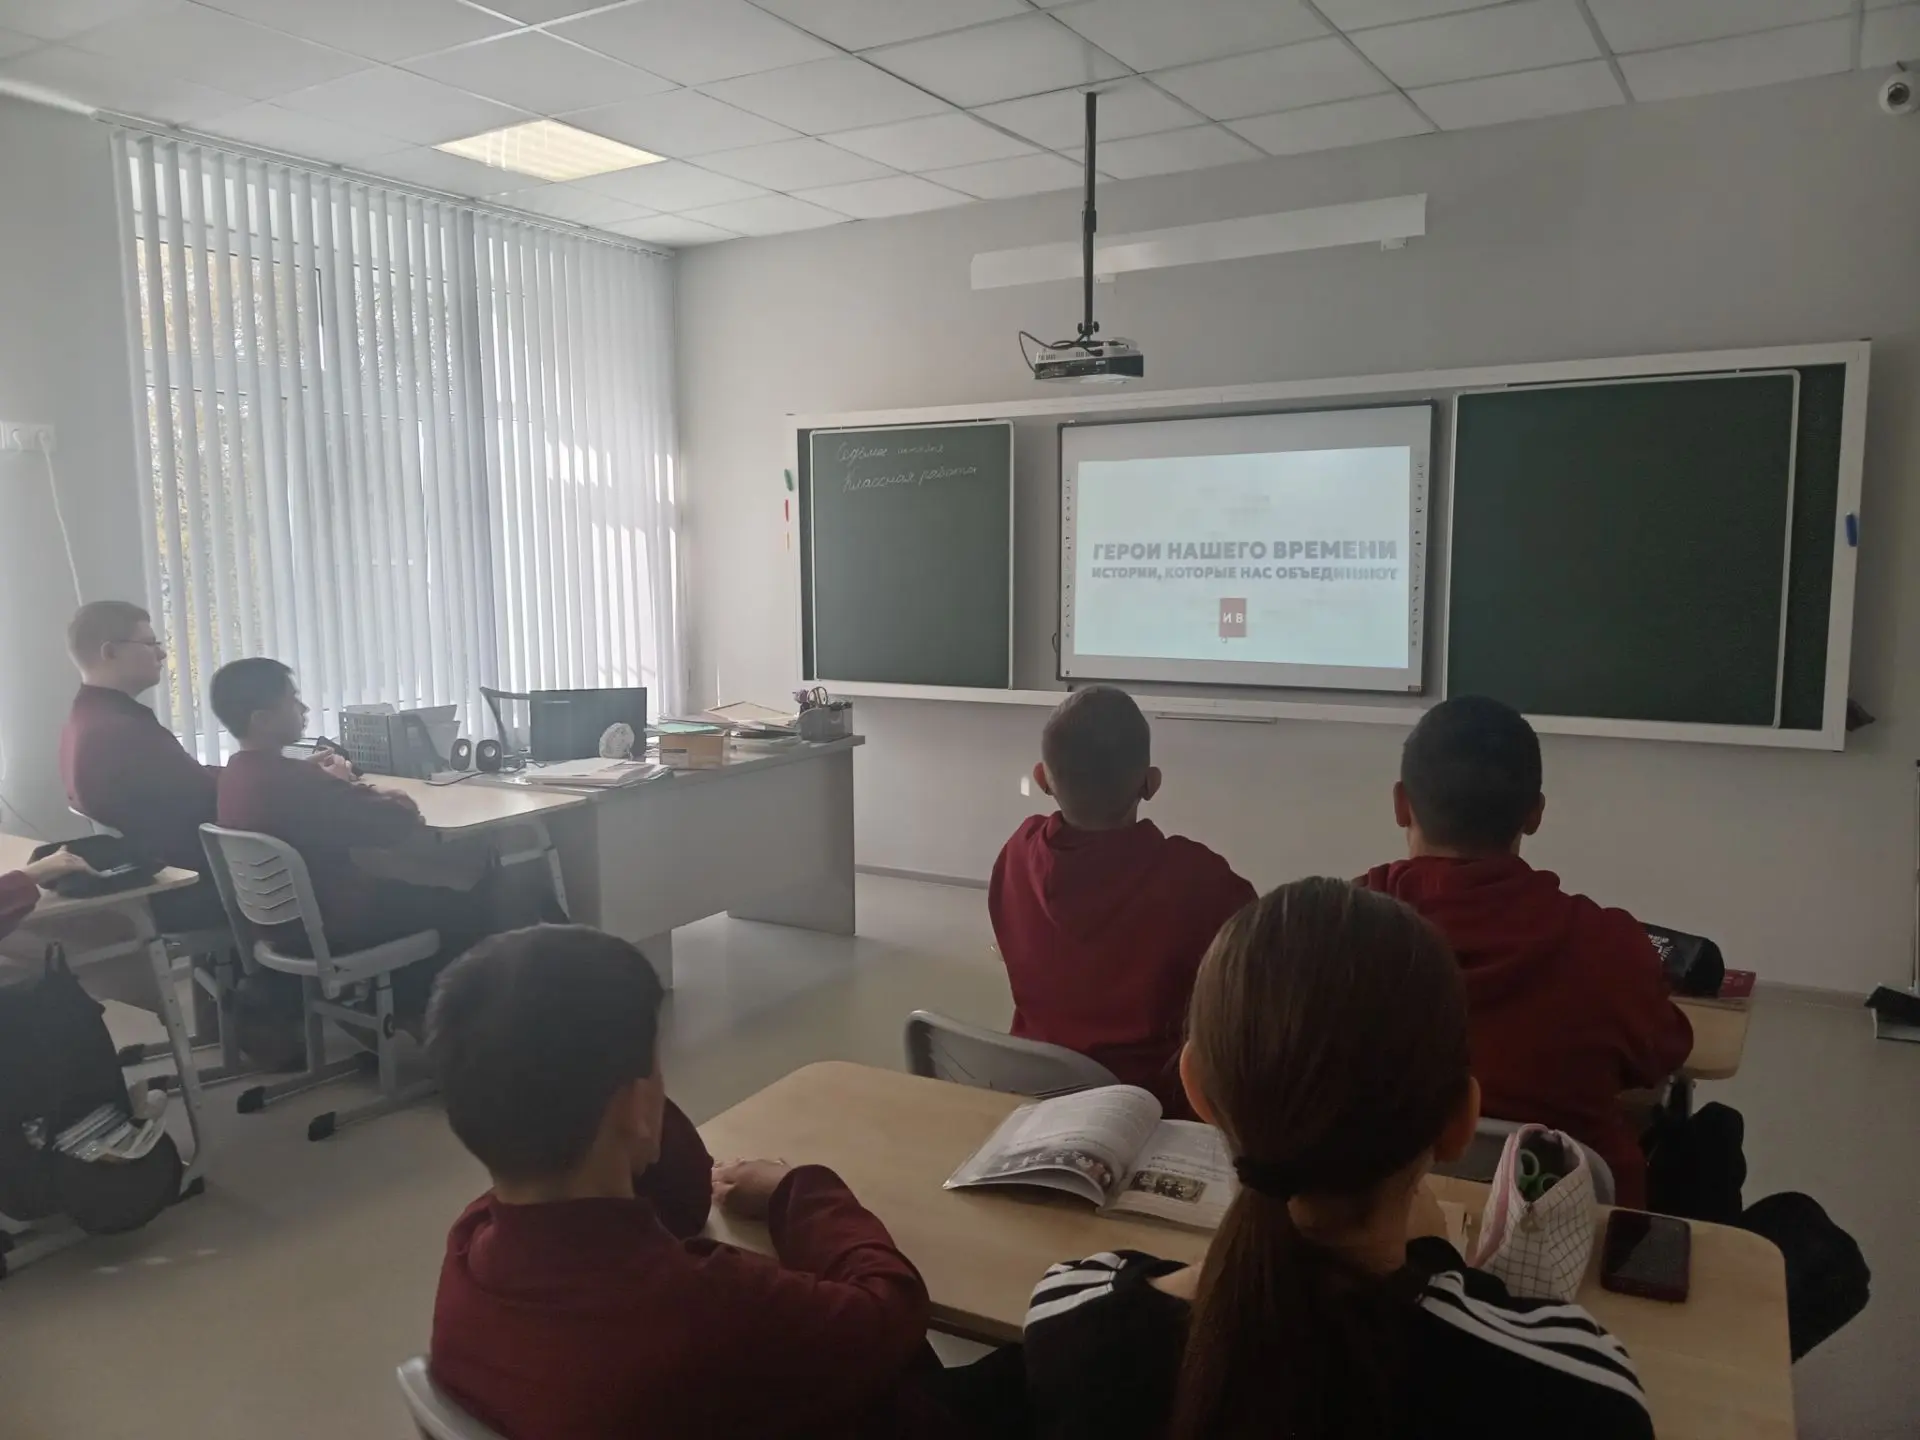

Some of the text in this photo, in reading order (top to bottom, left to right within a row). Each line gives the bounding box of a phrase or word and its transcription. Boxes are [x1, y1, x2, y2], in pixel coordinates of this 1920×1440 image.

[1093, 541, 1397, 560] ГЕРОИ НАШЕГО ВРЕМЕНИ
[1092, 567, 1161, 580] ИСТОРИИ,
[1165, 567, 1237, 579] КОТОРЫЕ
[1241, 566, 1272, 579] НАС
